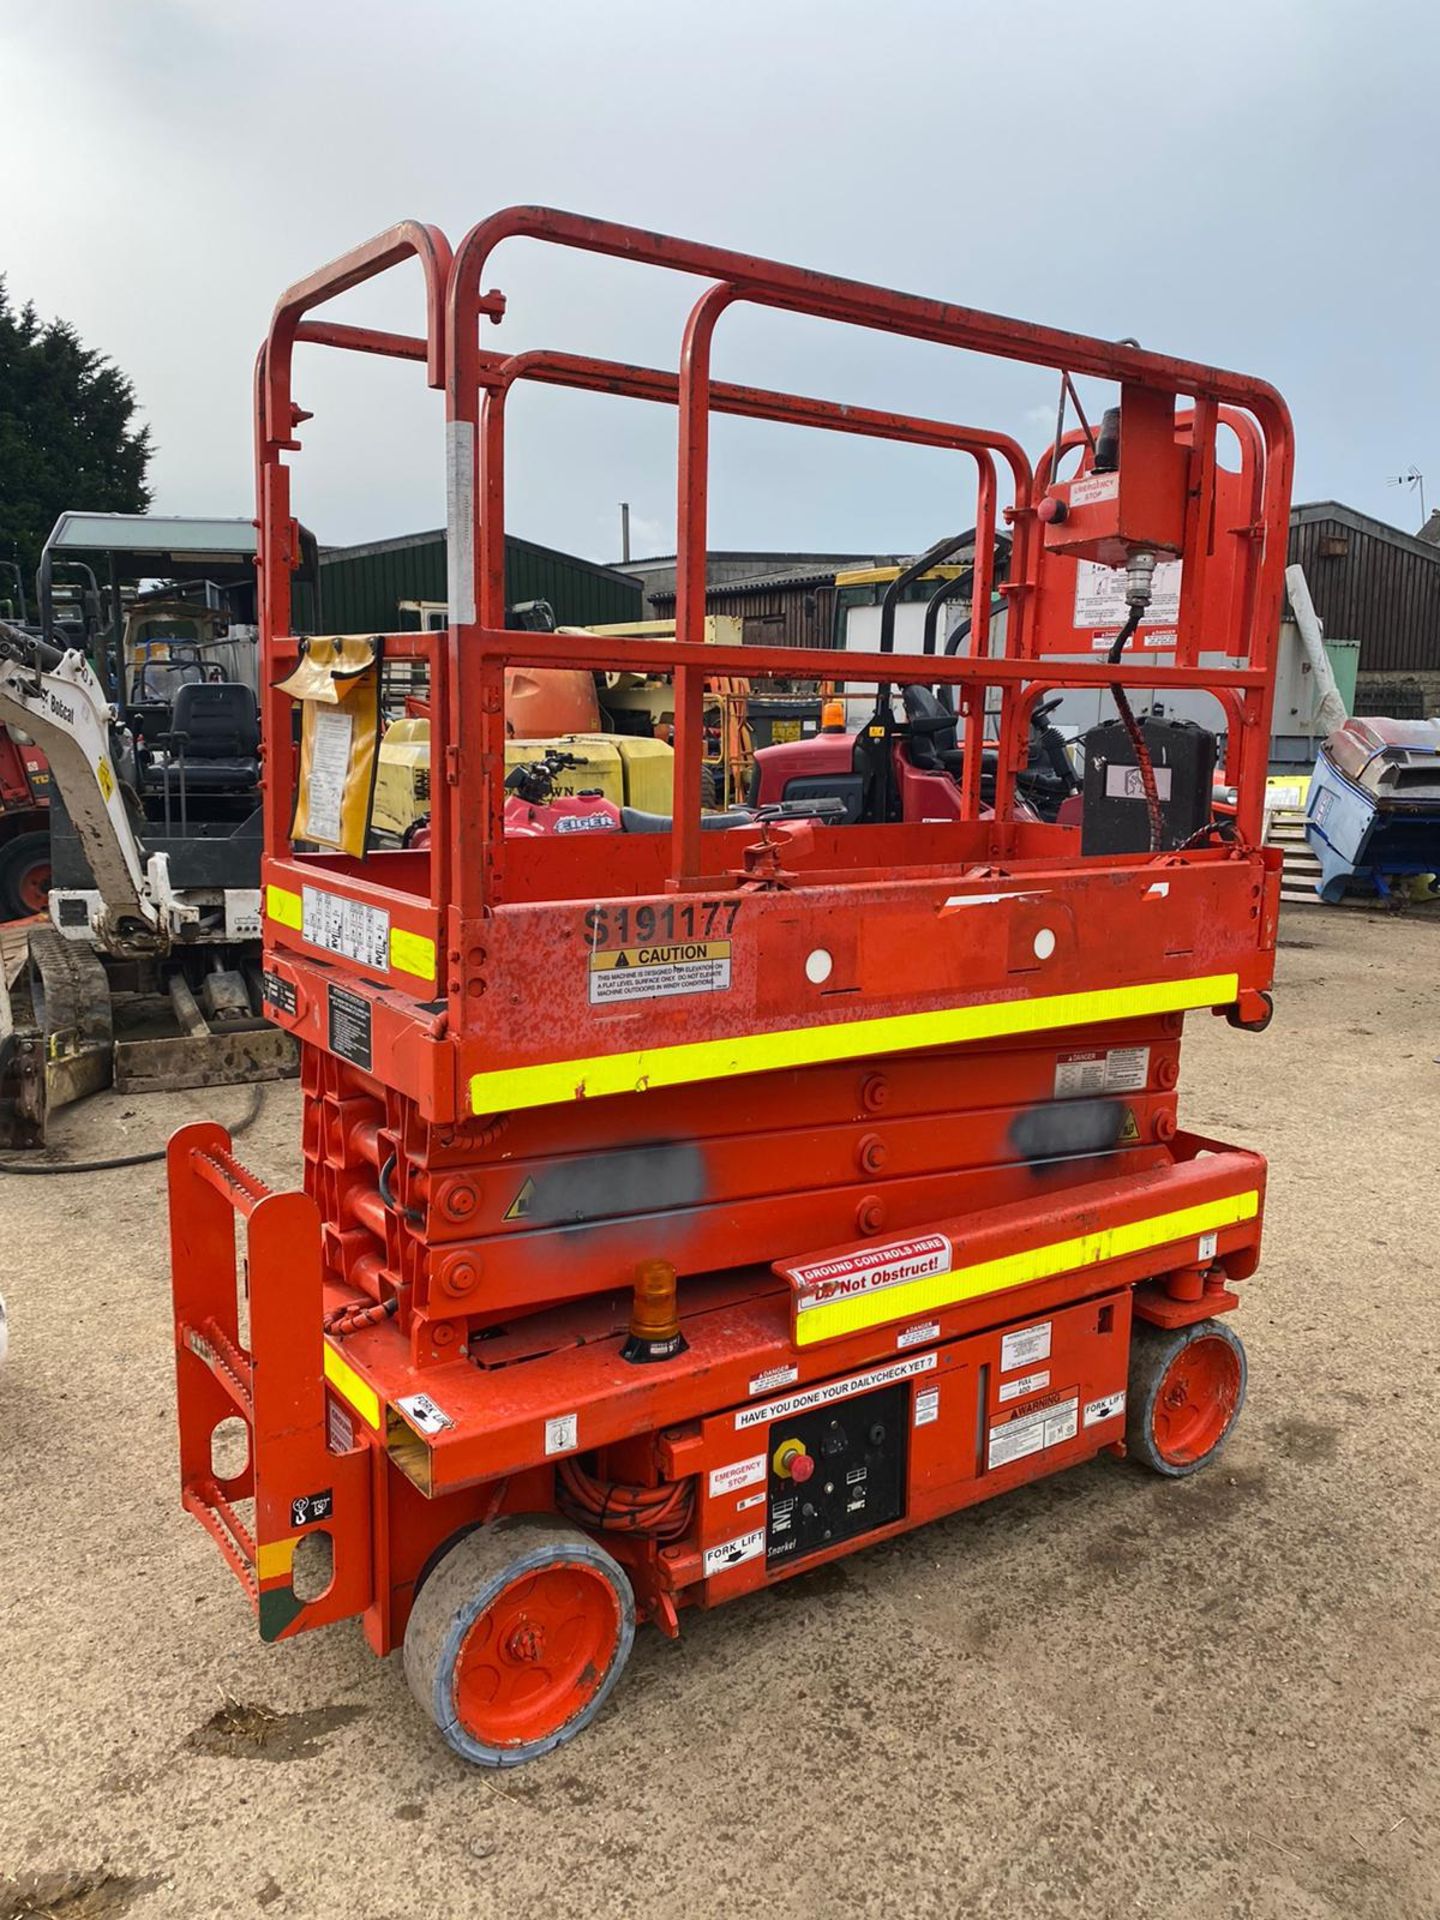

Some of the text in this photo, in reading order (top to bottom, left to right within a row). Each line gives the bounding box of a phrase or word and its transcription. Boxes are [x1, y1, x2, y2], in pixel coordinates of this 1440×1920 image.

[1085, 490, 1103, 501] STOP
[51, 694, 74, 725] Bobcat
[556, 814, 615, 831] EIGER
[583, 900, 742, 945] S191177
[638, 945, 708, 964] CAUTION
[611, 971, 636, 980] MACHINE
[644, 967, 672, 977] DESIGNED
[685, 963, 714, 973] ELEVATION
[616, 979, 633, 987] LEVEL
[634, 976, 660, 986] SURFACE
[700, 970, 722, 979] ELEVATE
[597, 988, 623, 997] MACHINE
[624, 984, 655, 994] OUTDOORS
[804, 1238, 943, 1280] GROUND CONTROLS HERE
[840, 1277, 877, 1295] Not
[871, 1257, 939, 1286] Obstruct!
[741, 1356, 934, 1425] HAVE YOU DONE YOUR DAILYCHECK YET ?
[415, 1396, 434, 1414] FORK
[1017, 1391, 1061, 1416] WARNING
[1086, 1401, 1106, 1414] FORK
[1109, 1393, 1125, 1406] LIFT
[714, 1462, 761, 1482] EMERGENCY
[728, 1475, 748, 1488] STOP
[707, 1532, 764, 1561] FORK LIFT
